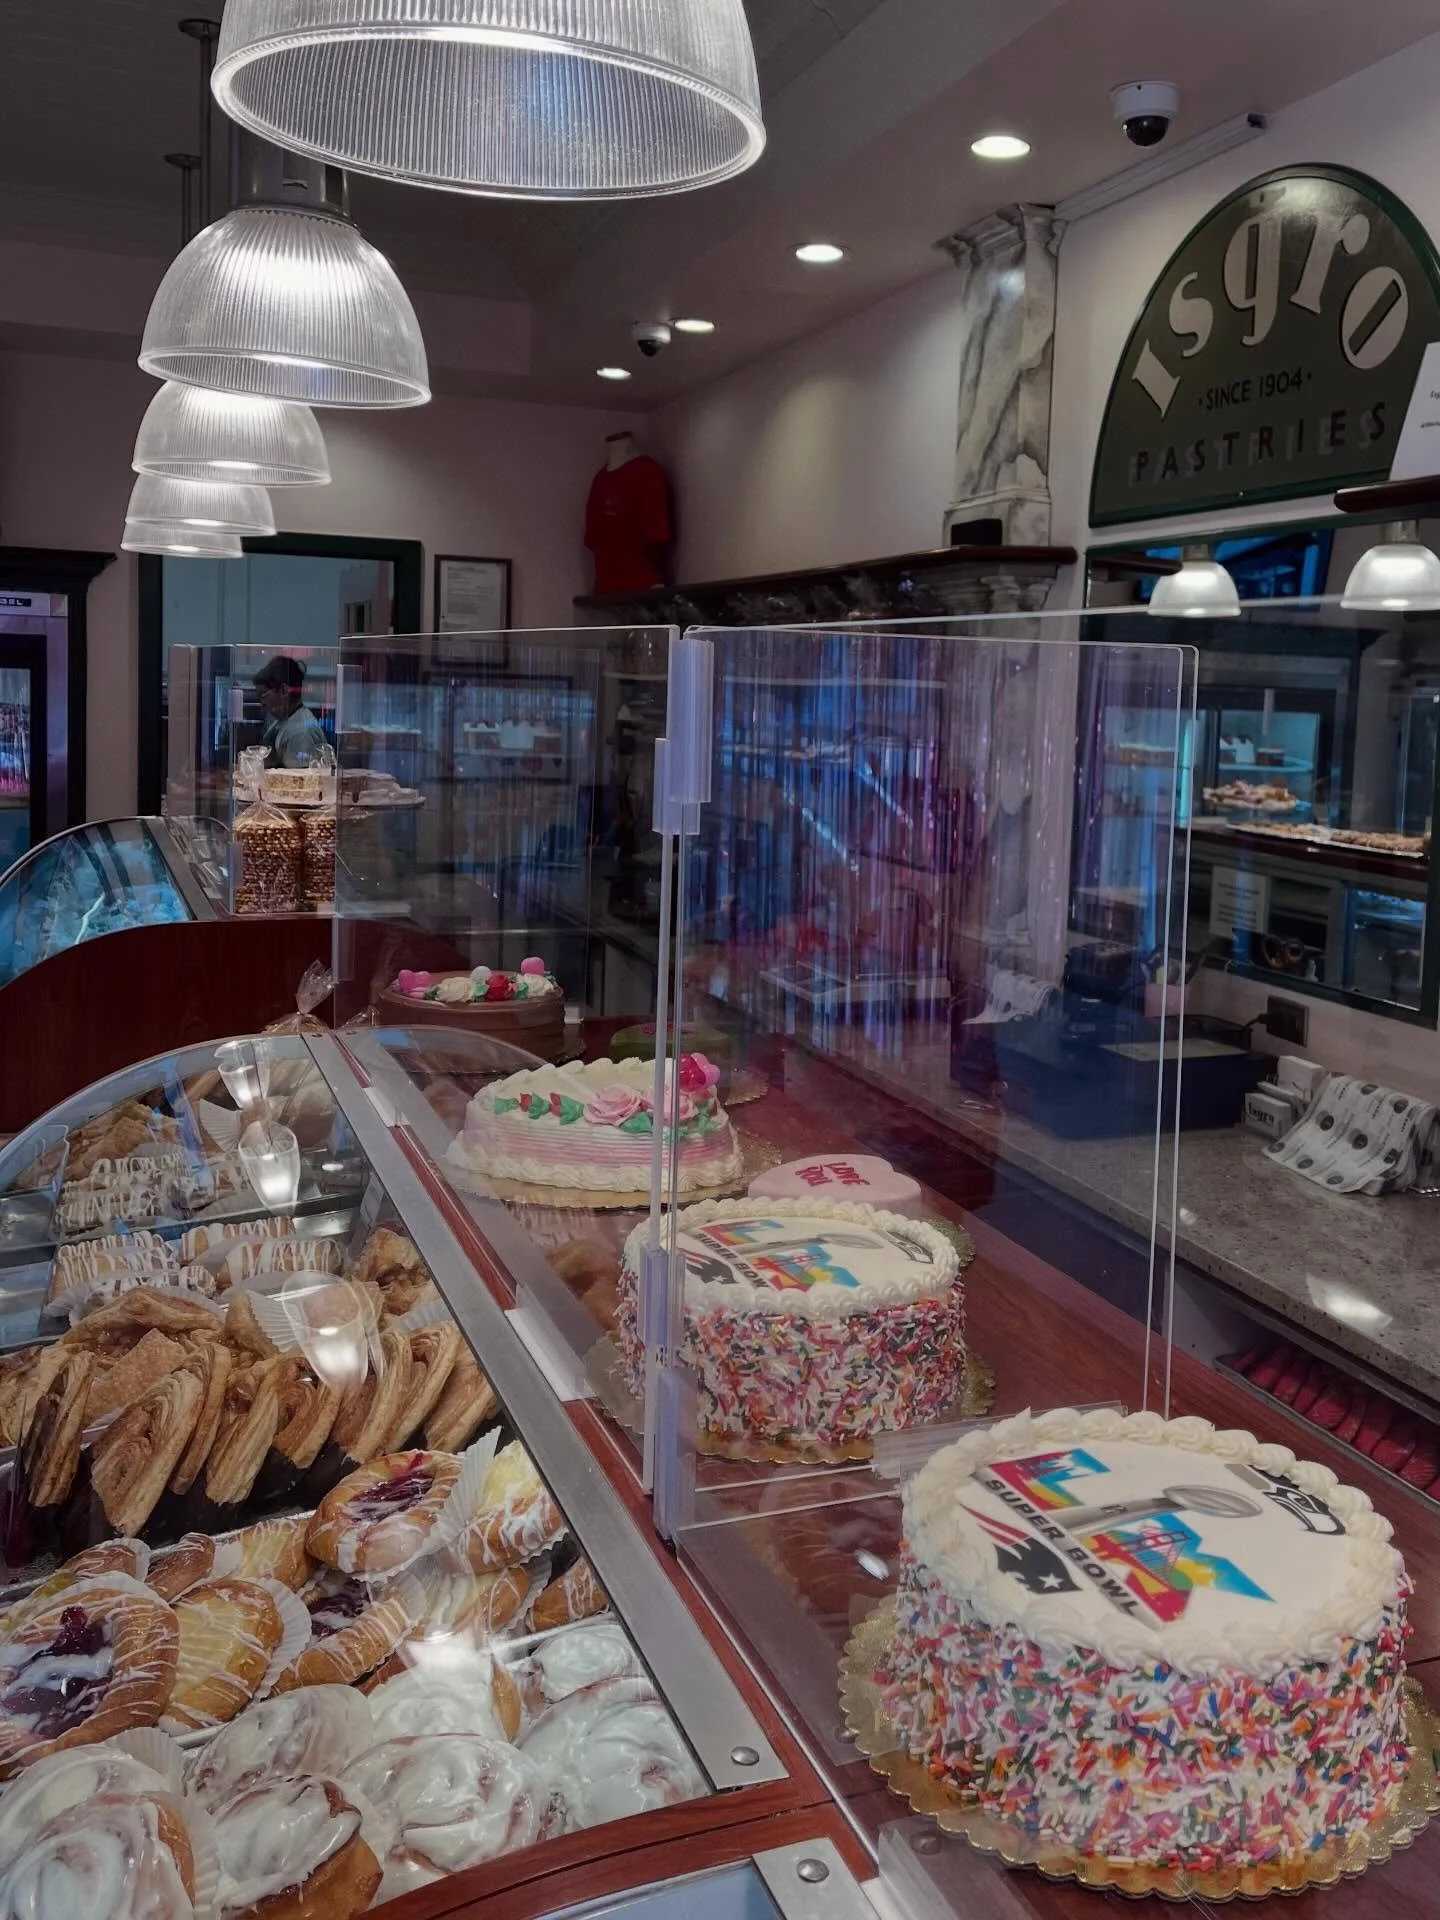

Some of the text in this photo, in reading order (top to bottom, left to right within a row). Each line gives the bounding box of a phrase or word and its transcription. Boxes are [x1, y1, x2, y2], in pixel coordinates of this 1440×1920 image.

[1206, 366, 1303, 410] SINCE 1904
[1129, 402, 1386, 486] PASTRIES
[695, 1232, 770, 1288] SUPER BOW
[984, 1478, 1139, 1617] SUPER BOWL
